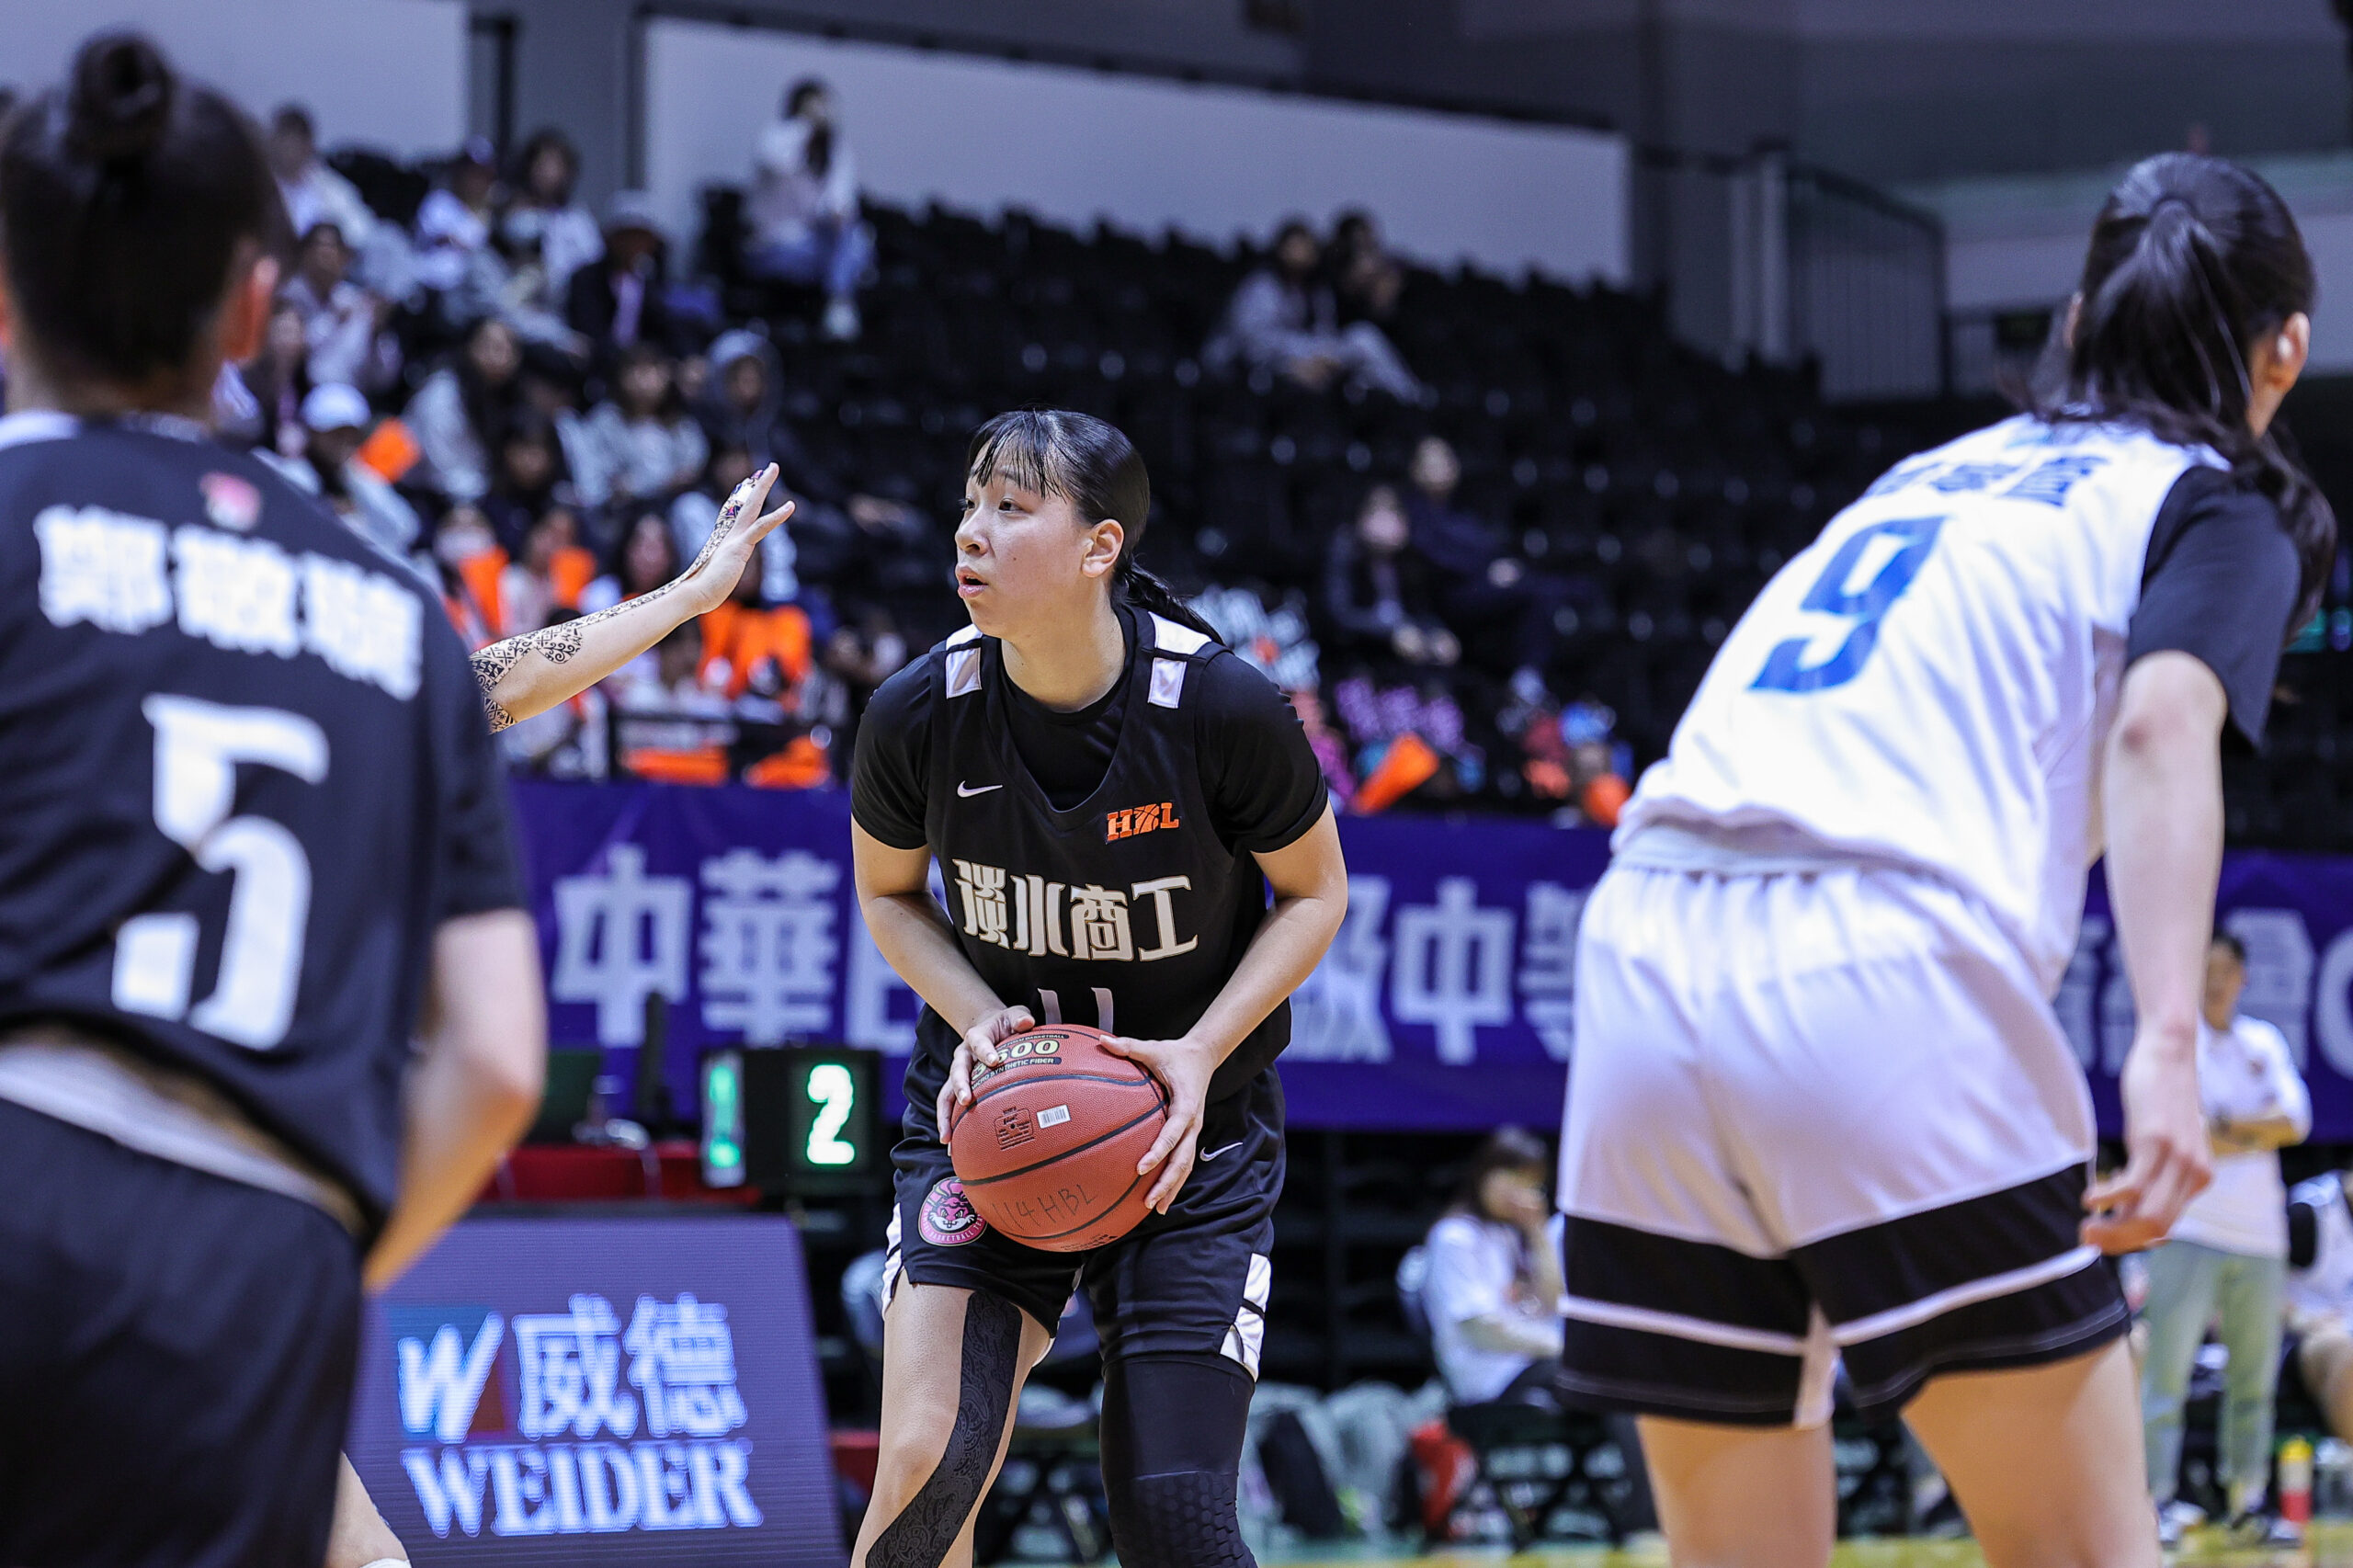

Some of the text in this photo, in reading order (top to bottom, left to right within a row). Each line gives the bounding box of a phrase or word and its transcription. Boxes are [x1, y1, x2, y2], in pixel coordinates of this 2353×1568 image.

[1745, 516, 1947, 694] 9
[141, 693, 330, 1051] 5
[1106, 802, 1180, 842] HBL
[952, 858, 1199, 962] 淡水商工
[1029, 1057, 1054, 1065] FIBER
[807, 1063, 856, 1165] 2
[511, 1291, 748, 1440] 威德
[399, 1437, 764, 1539] WEIDER
